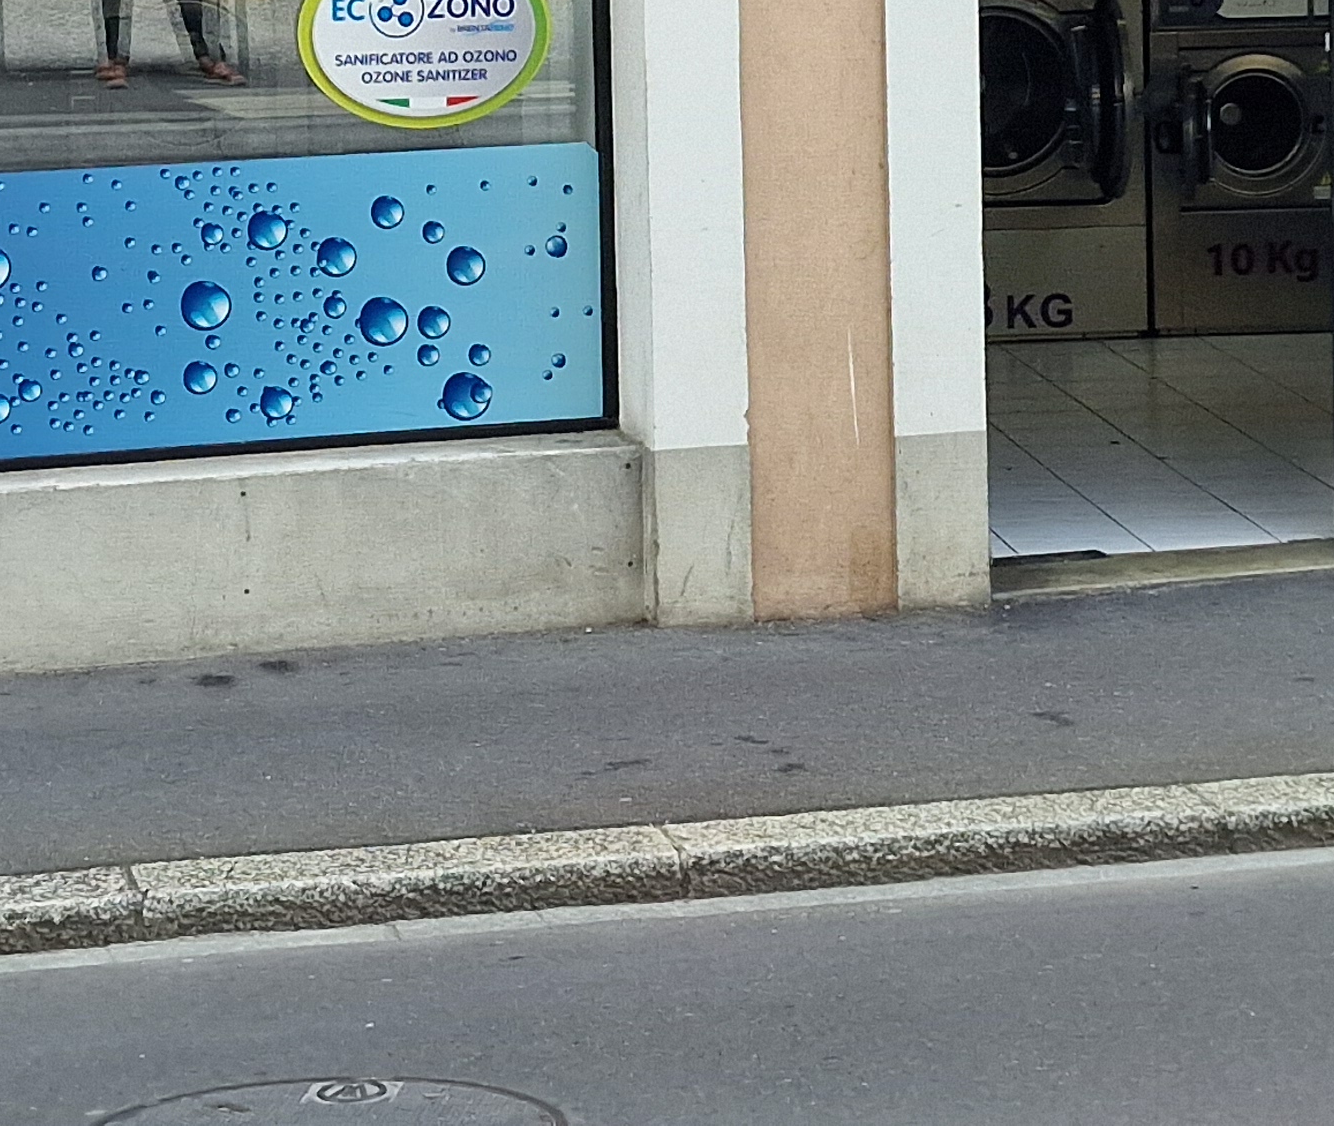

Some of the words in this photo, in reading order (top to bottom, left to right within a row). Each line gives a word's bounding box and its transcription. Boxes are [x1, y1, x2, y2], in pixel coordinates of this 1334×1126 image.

[334, 51, 434, 67] SANIFICATORE
[438, 50, 458, 64] AD
[462, 49, 517, 64] OZONO
[361, 70, 413, 84] OZONE
[417, 69, 488, 83] SANITIZER
[1207, 243, 1255, 276] 10
[1268, 240, 1318, 282] Kg
[1007, 293, 1074, 329] KG
